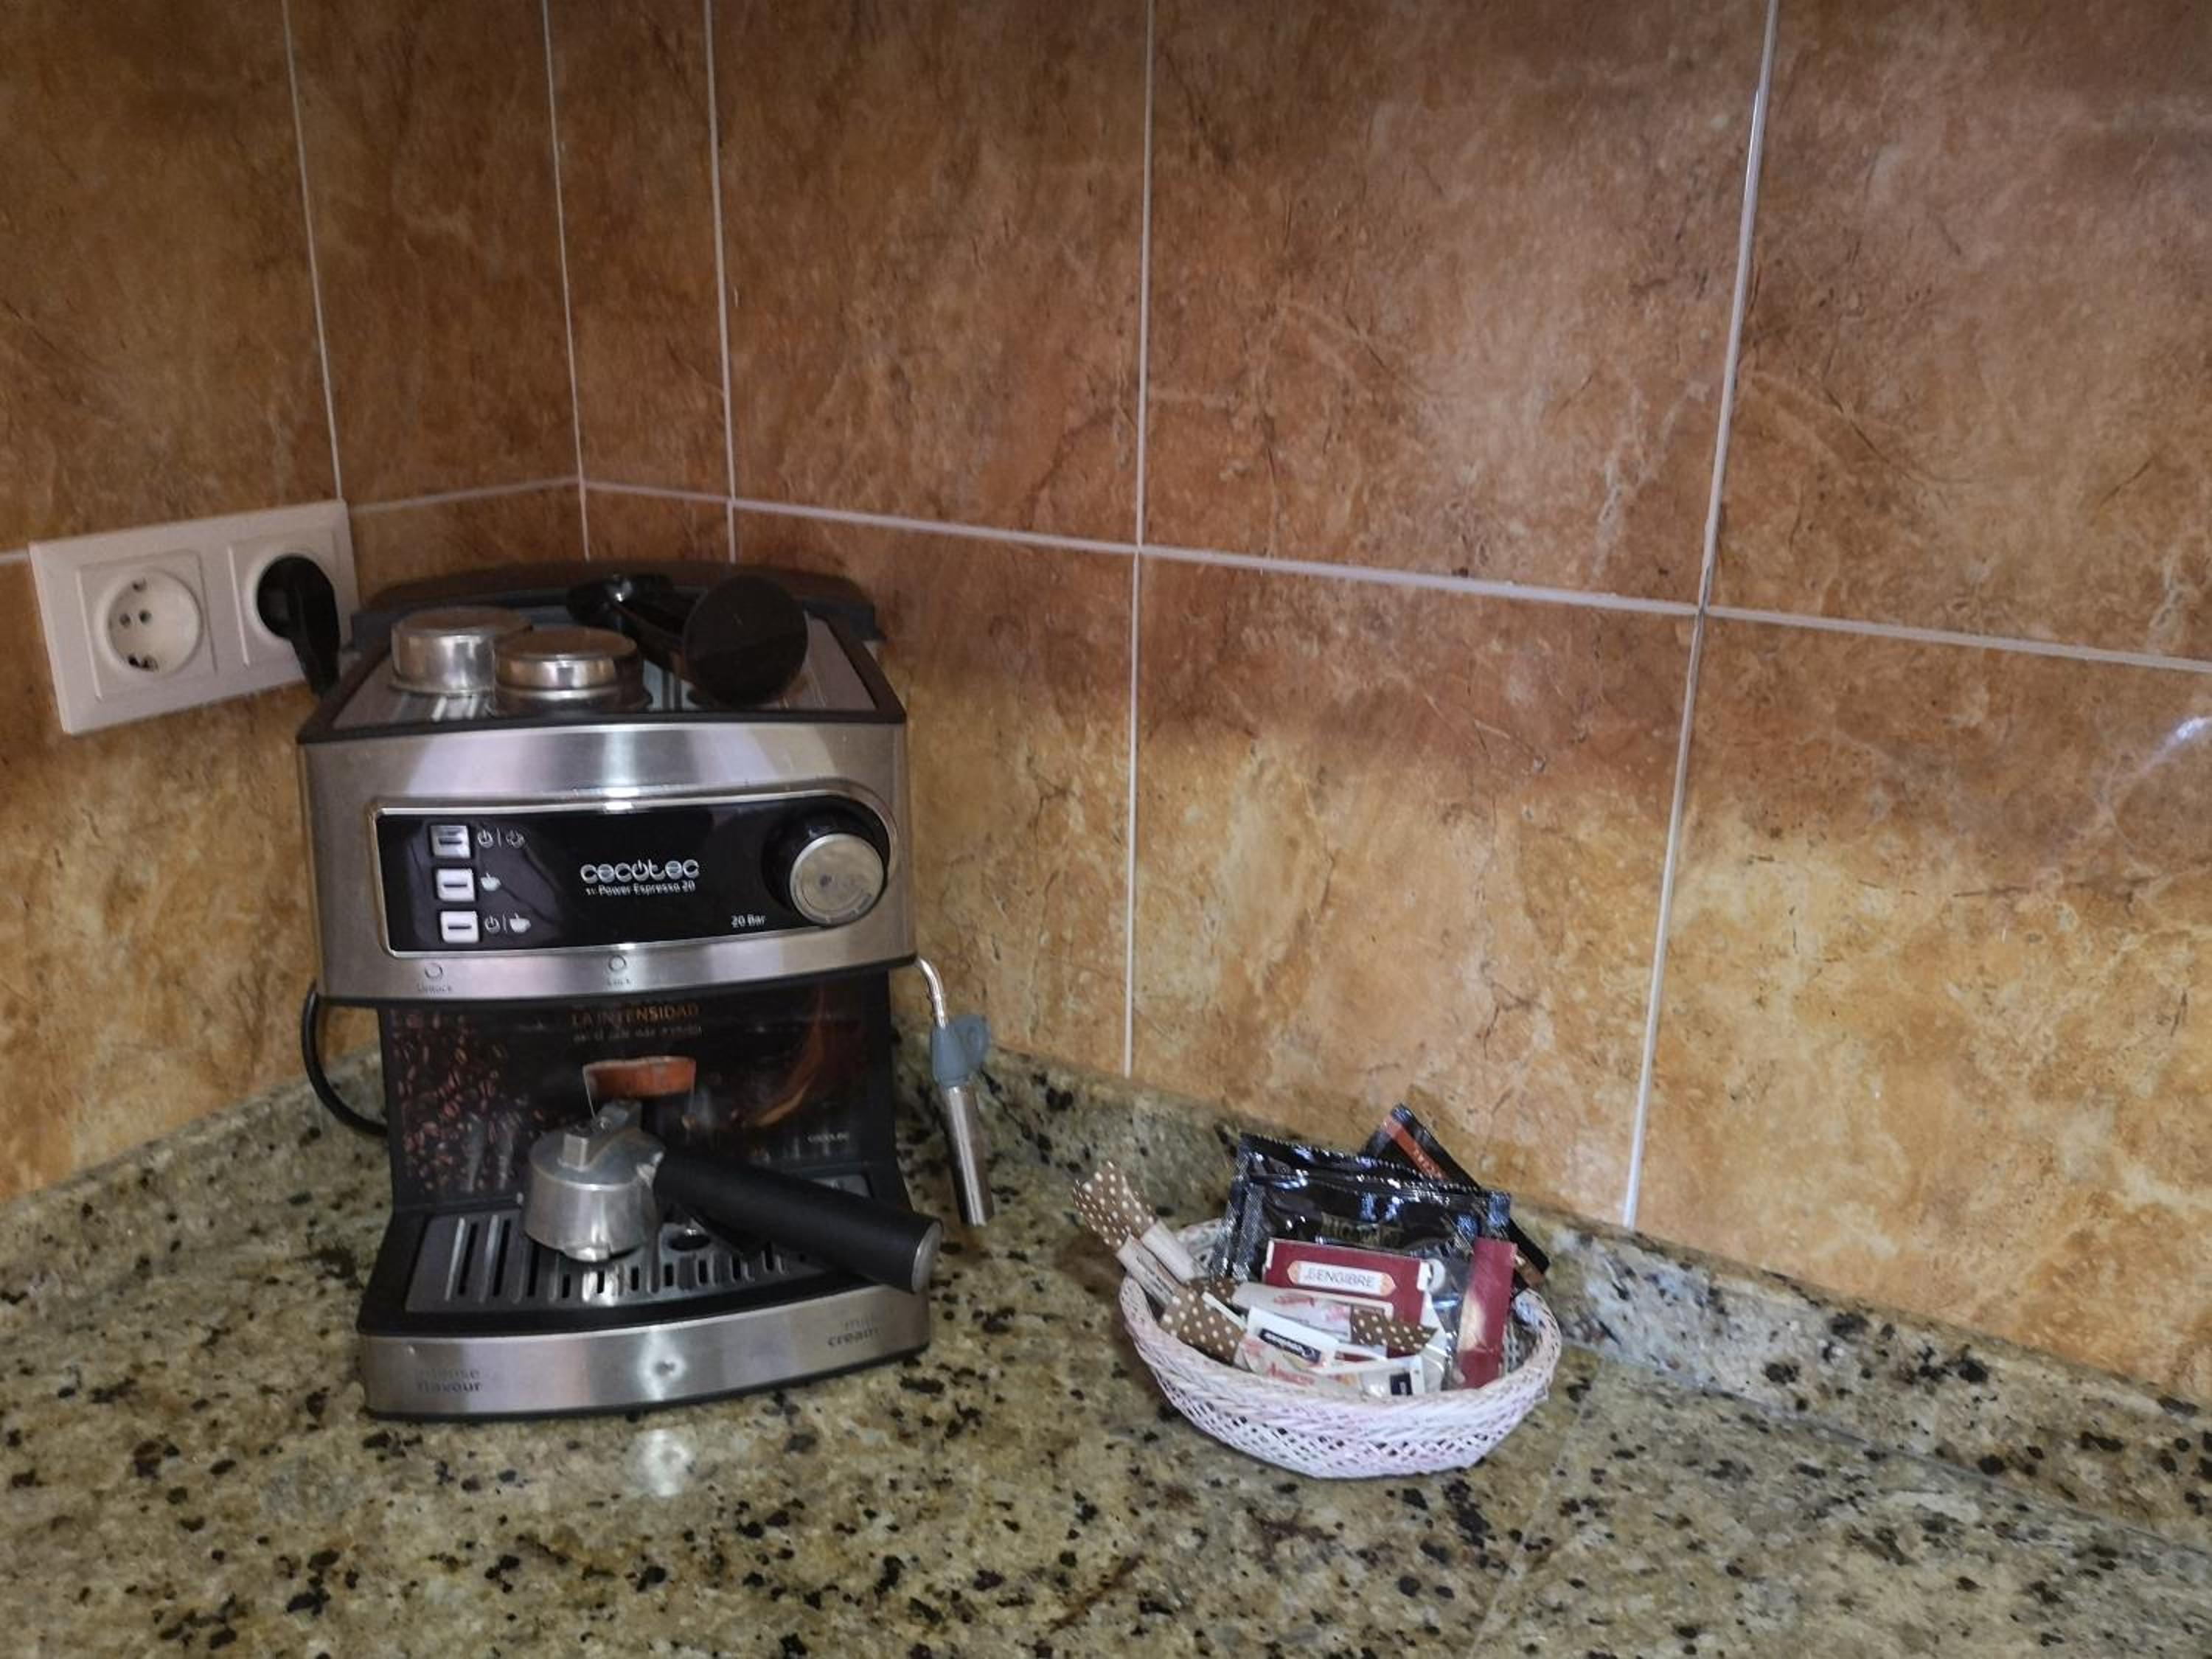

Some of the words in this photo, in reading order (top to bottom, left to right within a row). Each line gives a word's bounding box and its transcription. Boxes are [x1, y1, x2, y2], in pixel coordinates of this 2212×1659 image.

[598, 884, 630, 896] Power
[633, 882, 681, 896] Espresso
[681, 880, 696, 893] 20
[731, 915, 745, 928] 20
[747, 914, 766, 926] Bar
